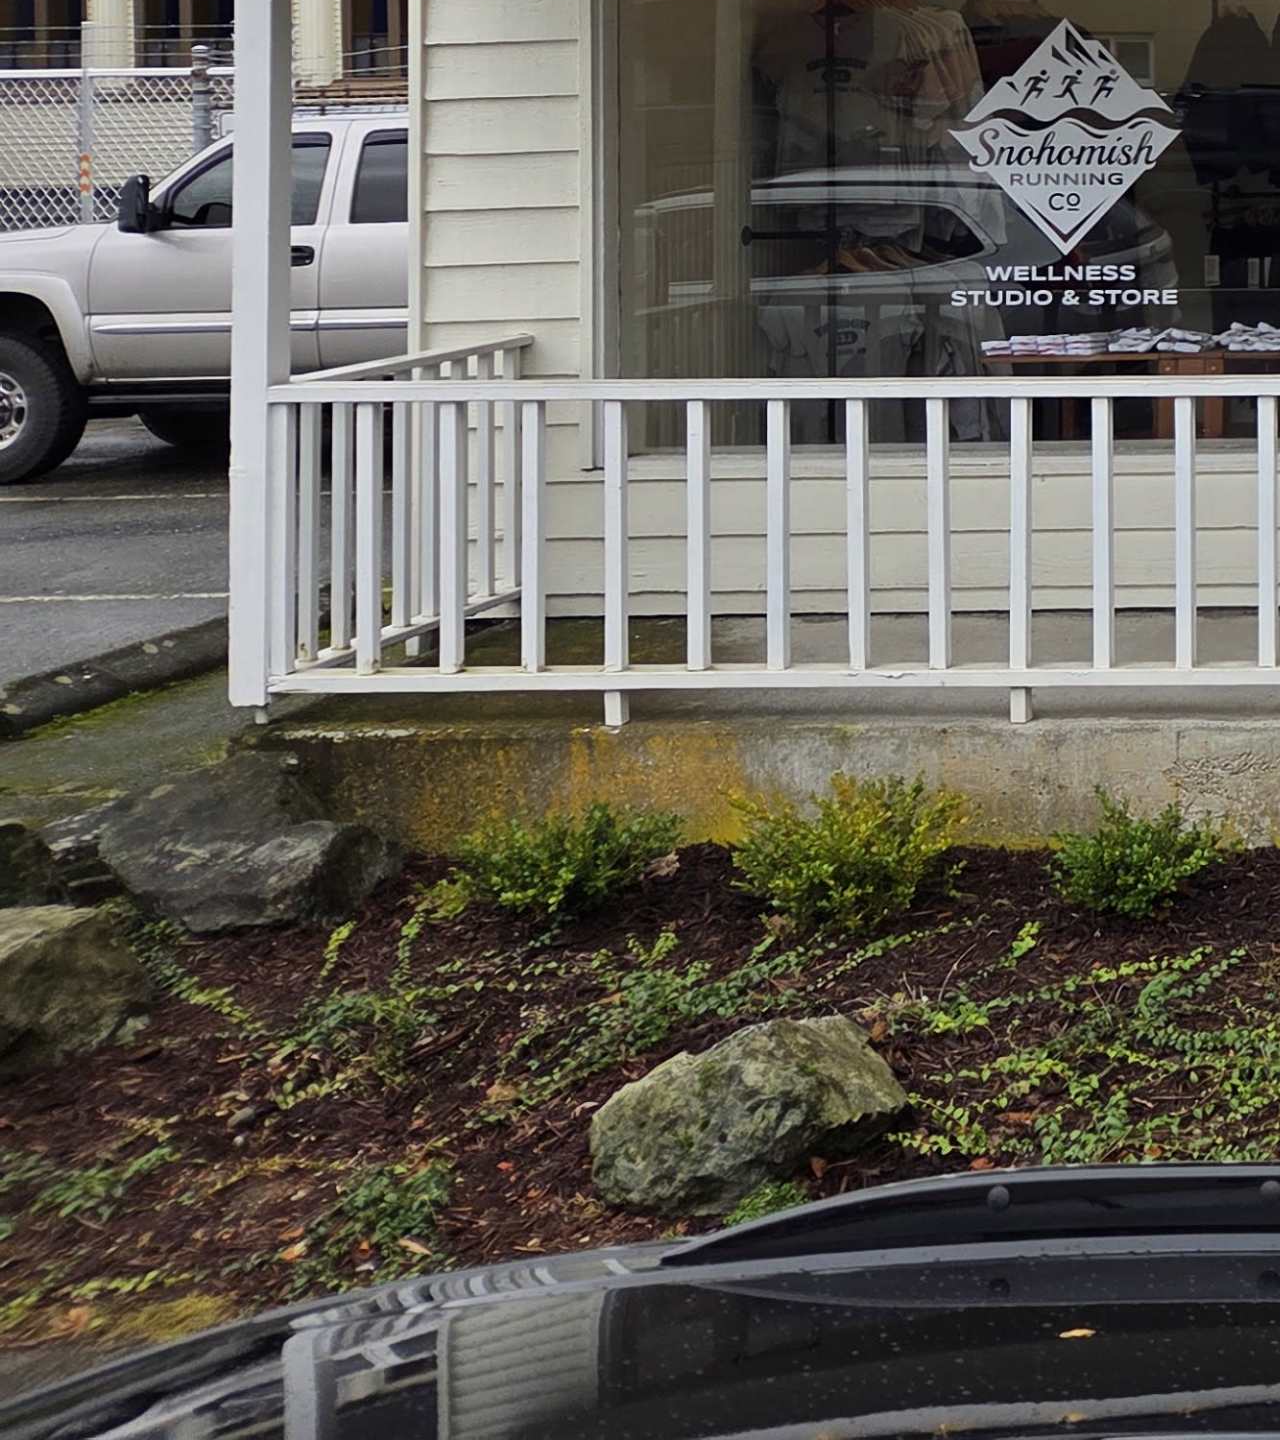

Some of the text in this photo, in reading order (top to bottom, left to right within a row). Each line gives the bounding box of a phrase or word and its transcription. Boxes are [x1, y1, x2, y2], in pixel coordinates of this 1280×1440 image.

[970, 127, 1155, 167] Snohomish
[1009, 172, 1124, 186] RUNNING
[985, 264, 1136, 281] WELLNESS
[950, 289, 1179, 307] STUDIO & STORE
